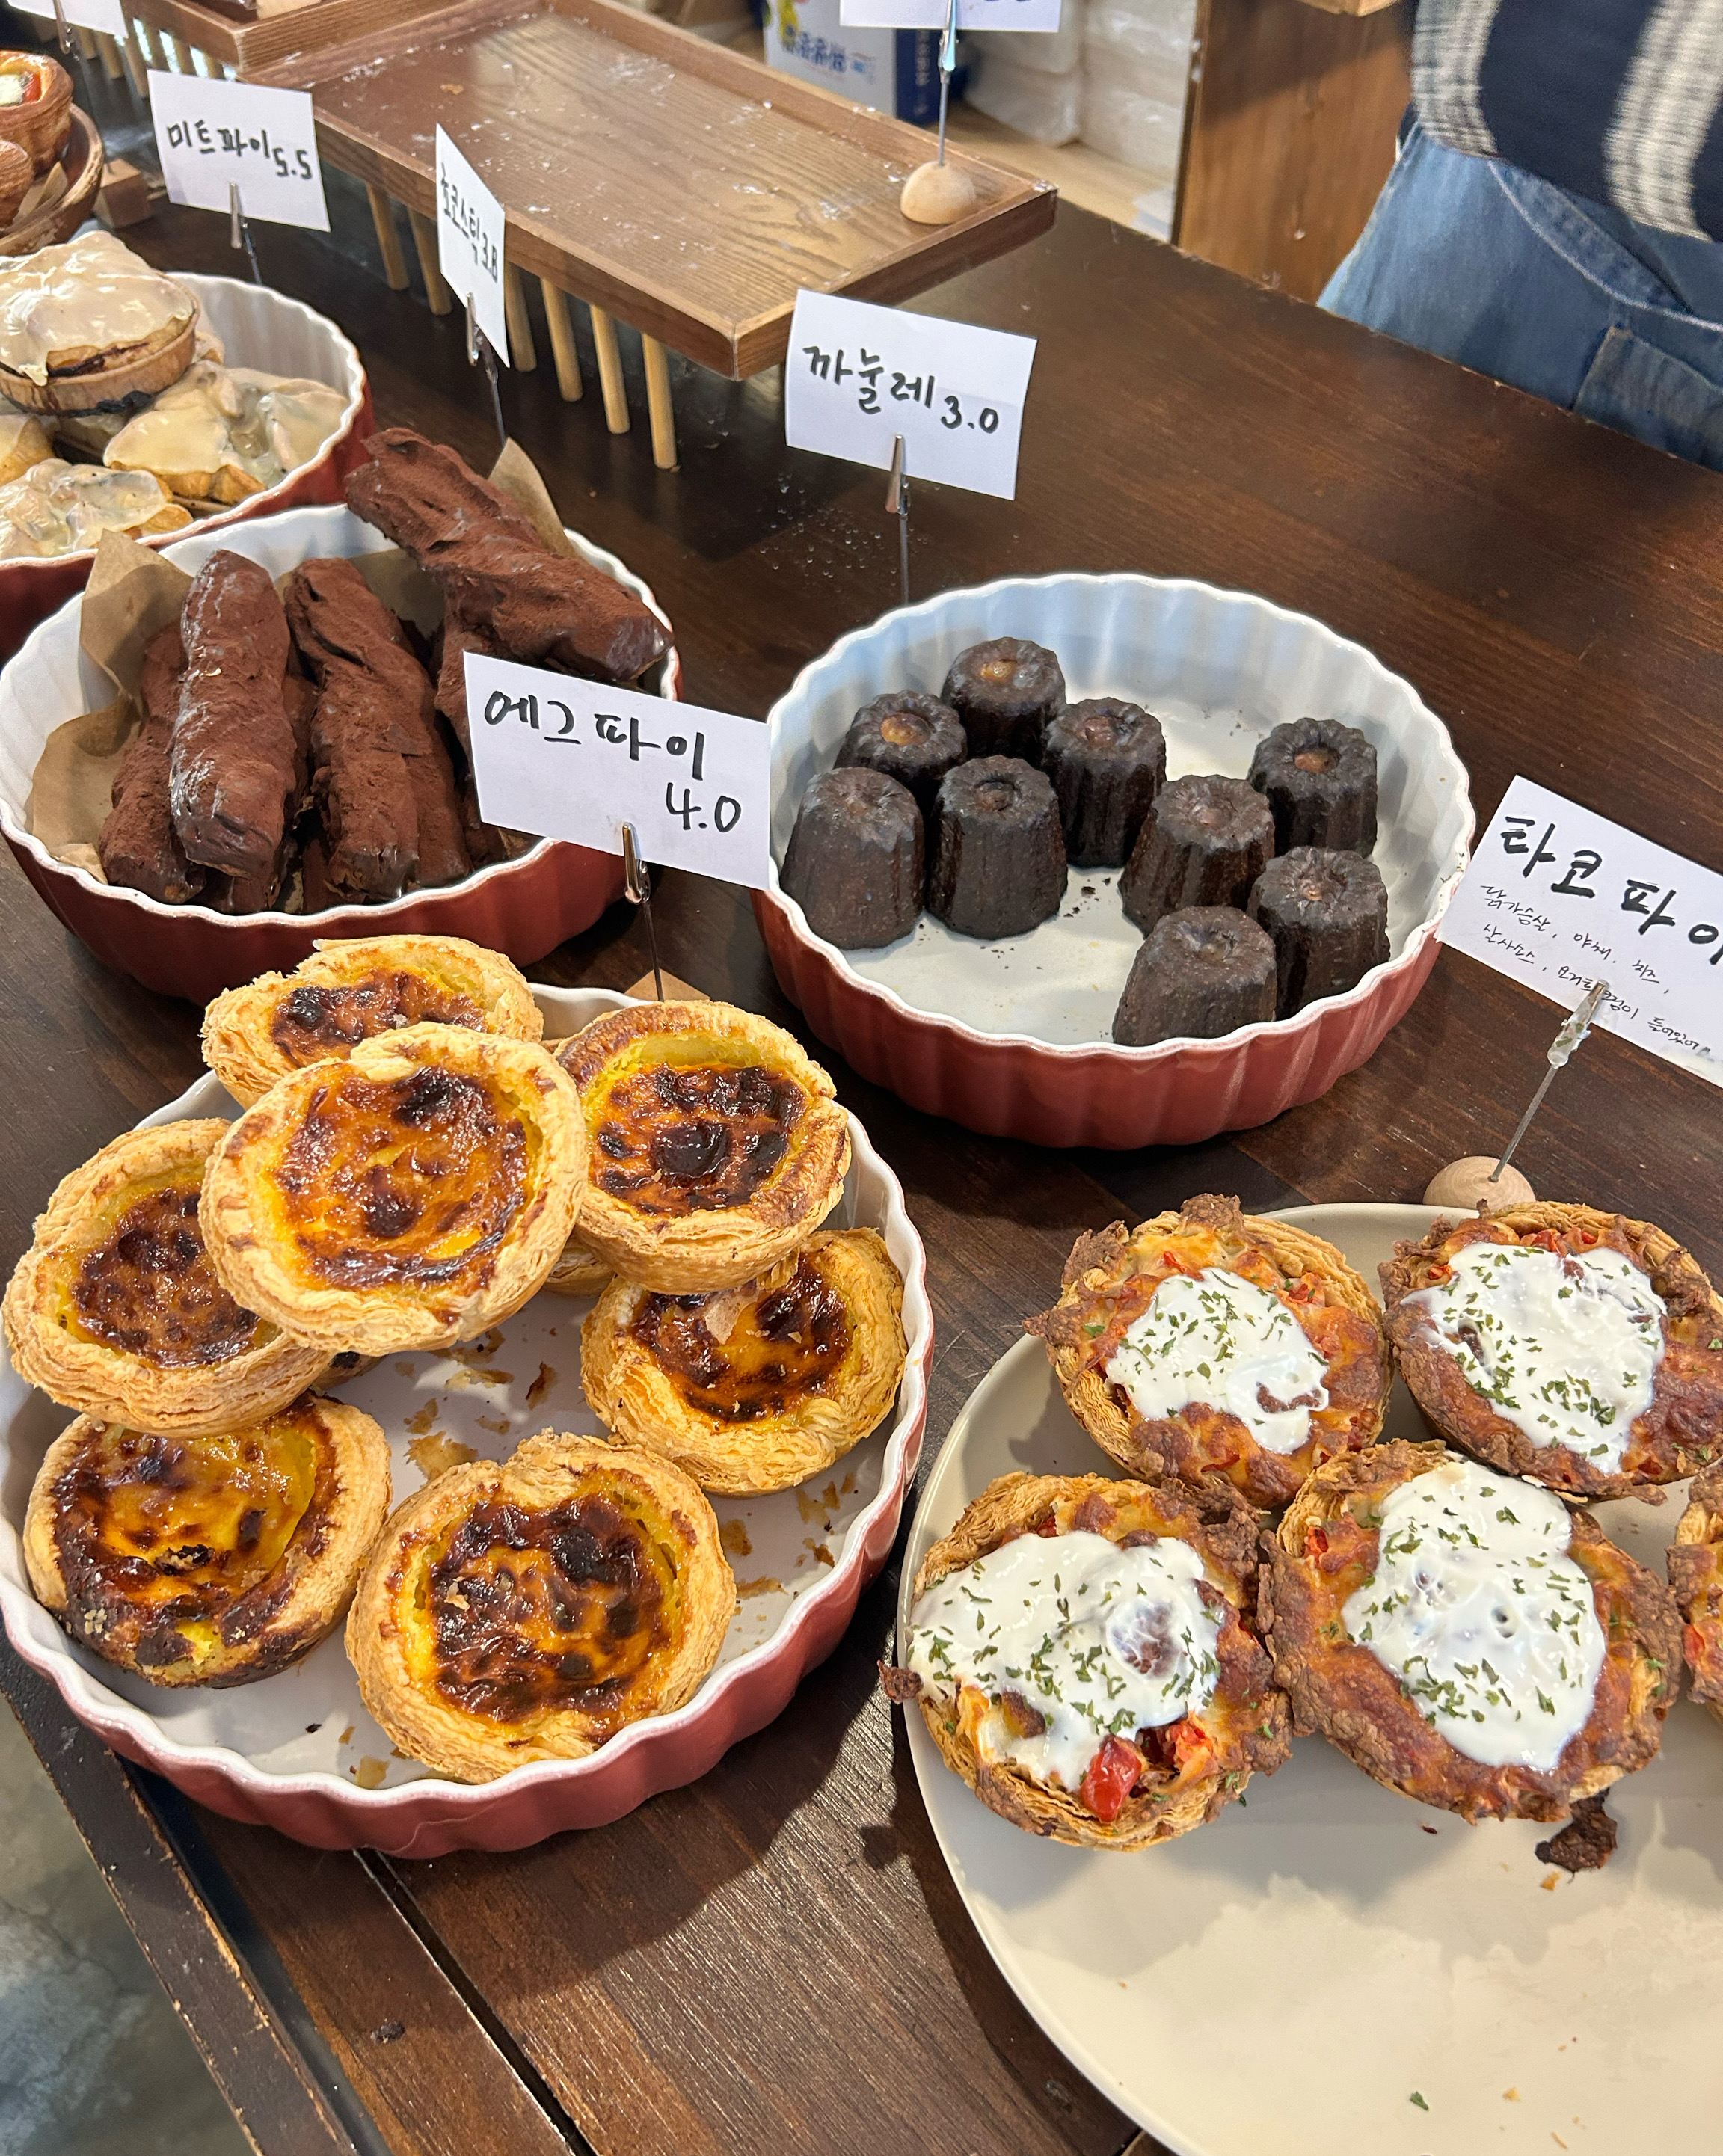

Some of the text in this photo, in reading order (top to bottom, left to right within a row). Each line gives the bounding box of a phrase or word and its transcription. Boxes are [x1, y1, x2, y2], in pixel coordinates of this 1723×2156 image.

[166, 119, 313, 180] 미트파이 5.5
[802, 345, 999, 434] 까눌레 3.0
[666, 781, 742, 833] 4.0
